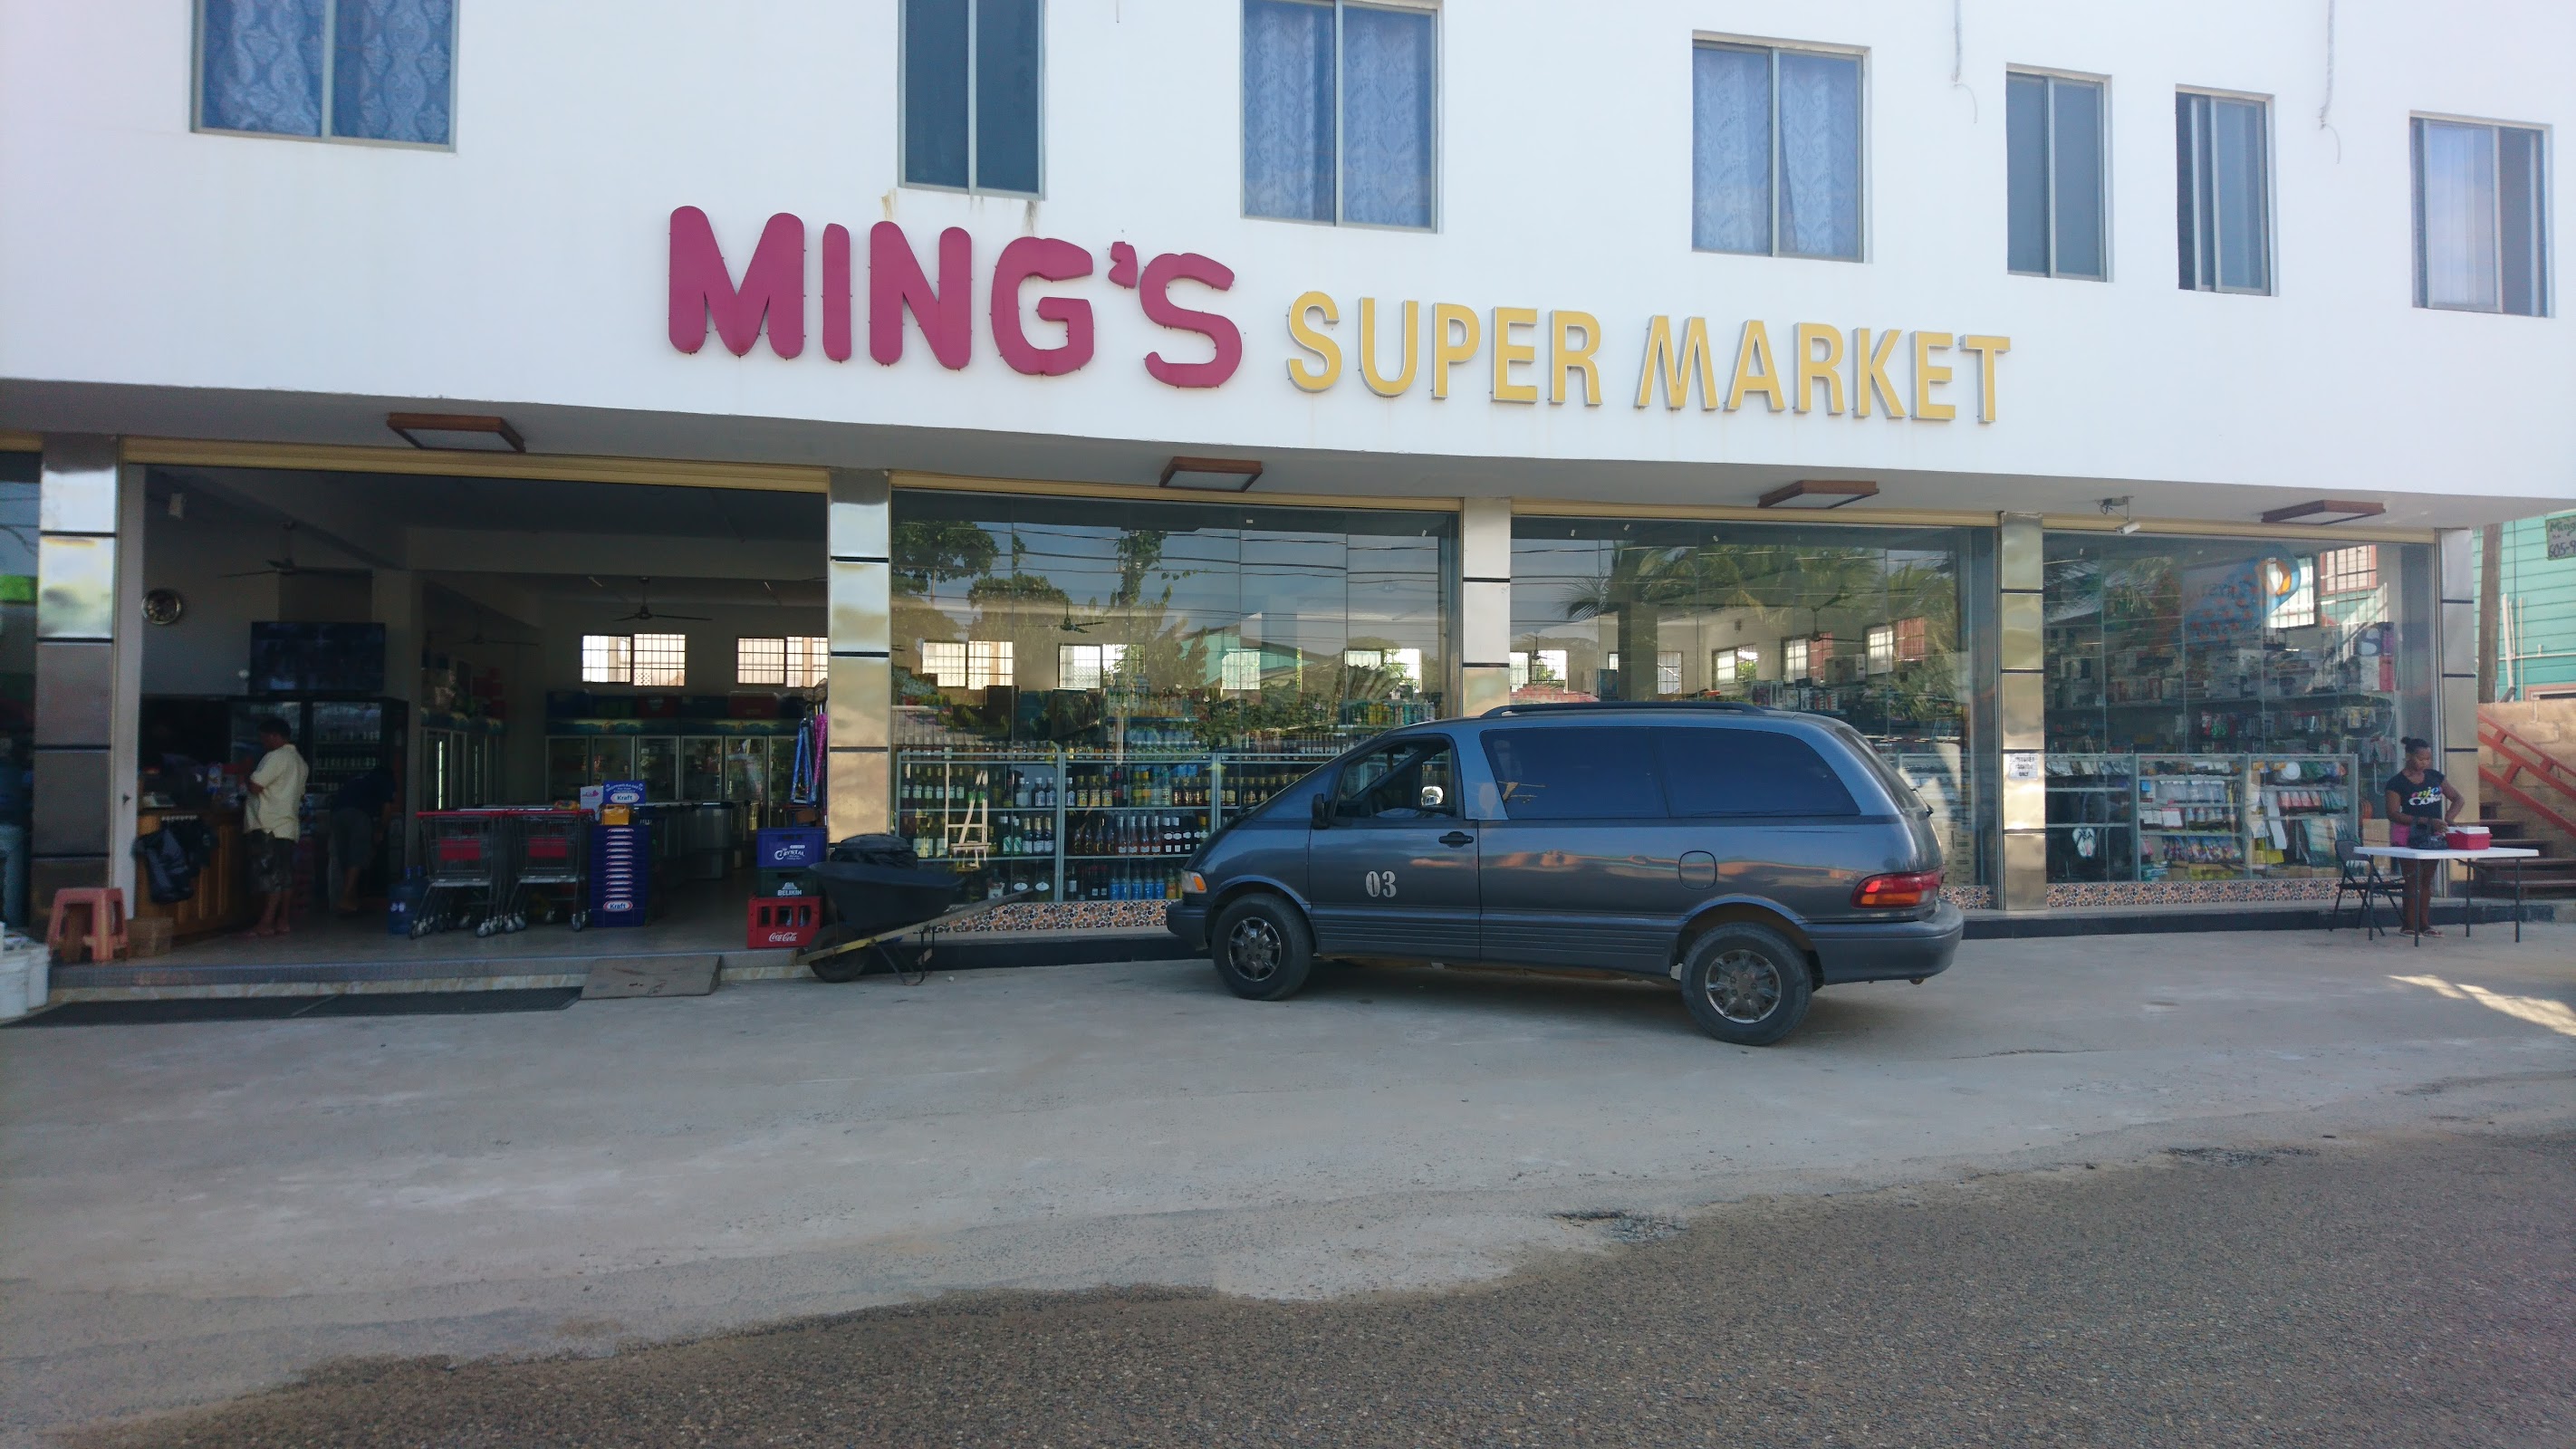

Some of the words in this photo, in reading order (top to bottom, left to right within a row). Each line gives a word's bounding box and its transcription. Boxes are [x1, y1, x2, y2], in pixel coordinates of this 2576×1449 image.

[668, 205, 1243, 389] MING'S
[1284, 291, 1602, 407] SUPER
[1634, 314, 2012, 423] MARKET
[1365, 870, 1397, 897] 03
